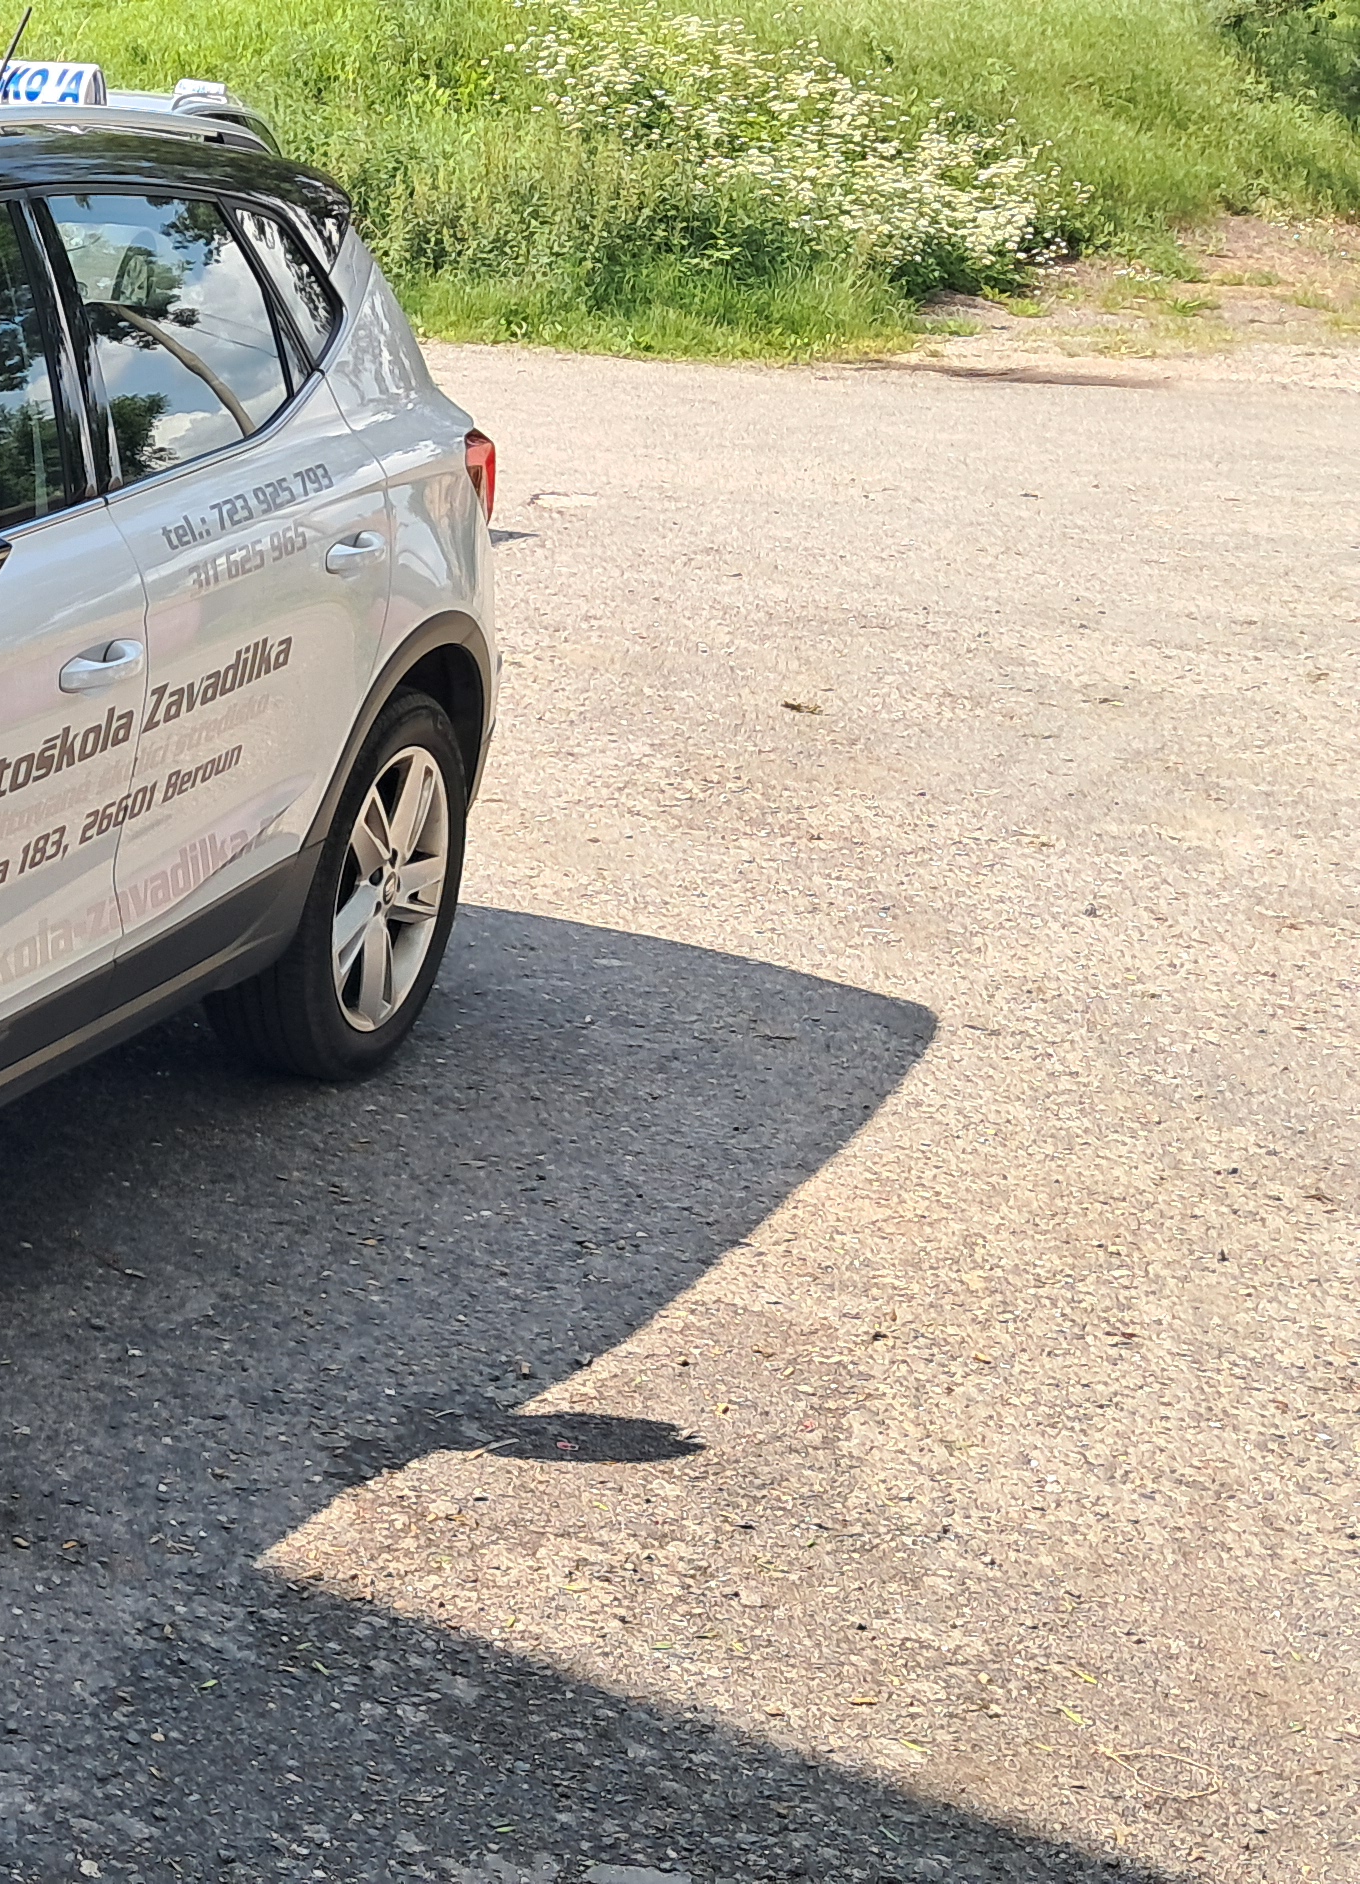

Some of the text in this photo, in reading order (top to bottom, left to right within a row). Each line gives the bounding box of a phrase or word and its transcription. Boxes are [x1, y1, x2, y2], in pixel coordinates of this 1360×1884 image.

[161, 463, 334, 551] tel.: 723 925 793
[225, 538, 265, 580] 625
[269, 521, 308, 563] 965
[142, 636, 293, 734] Zavadilka
[18, 824, 70, 876] 183,
[79, 781, 157, 846] 26601
[161, 744, 243, 805] Beroun
